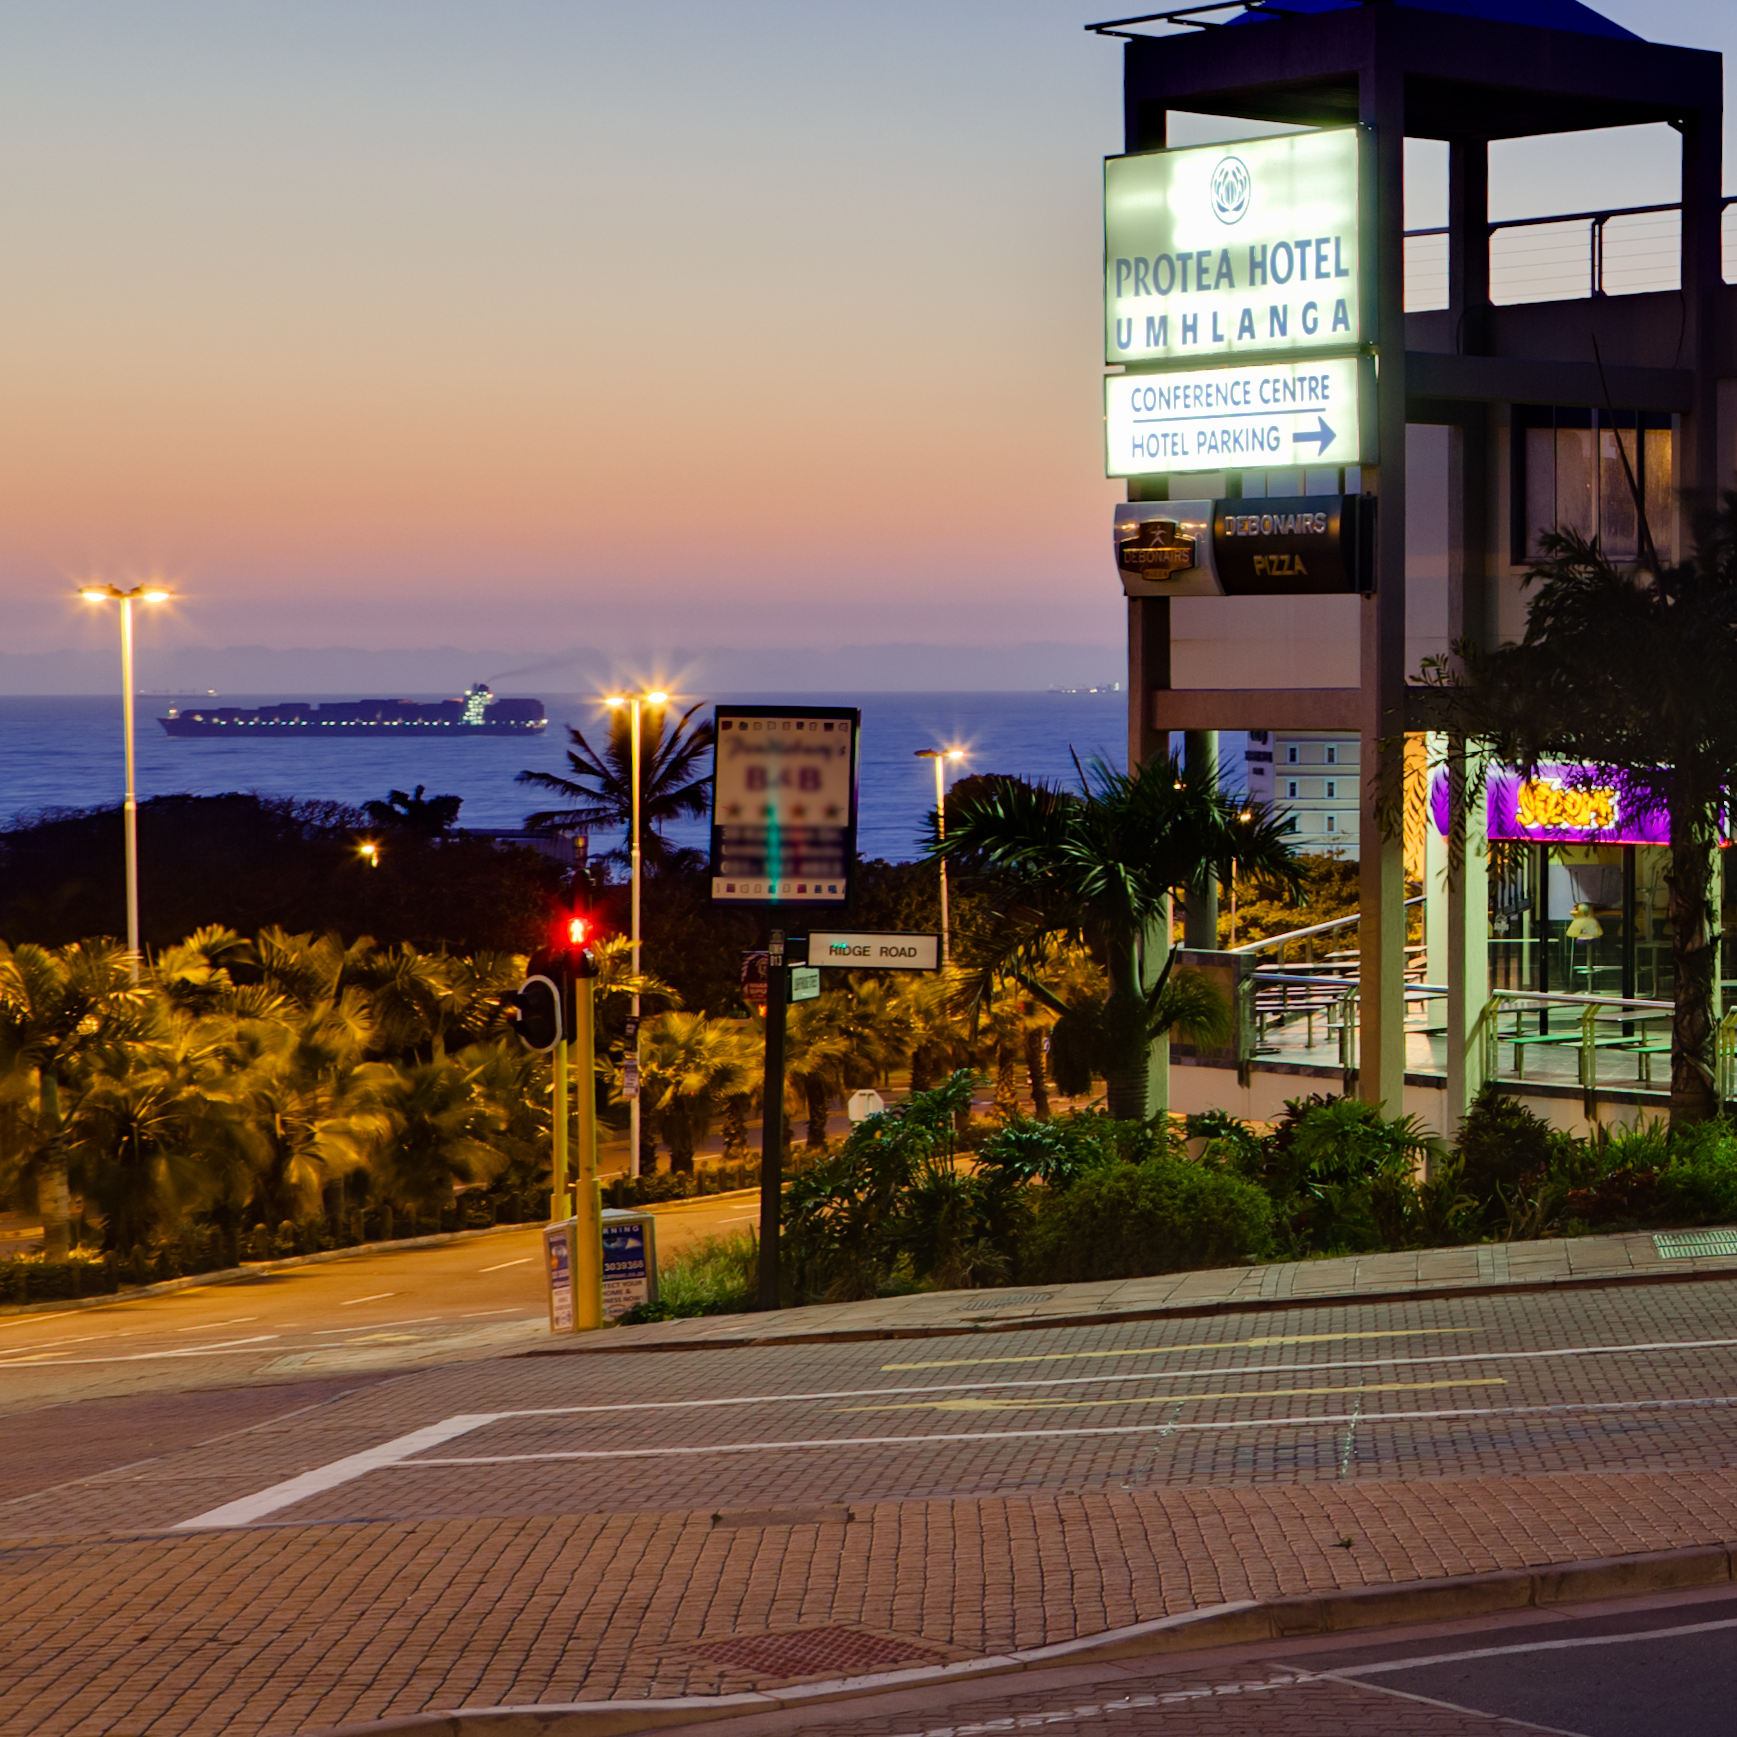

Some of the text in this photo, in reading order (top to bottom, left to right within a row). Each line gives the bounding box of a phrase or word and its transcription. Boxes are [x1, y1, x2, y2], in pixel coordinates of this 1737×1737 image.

[1115, 236, 1350, 298] PROTEA HOTEL
[1116, 298, 1350, 350] UMHLANGA
[1131, 375, 1330, 412] CONFERENCE CENTRE
[1132, 426, 1280, 458] HOTEL PARKING
[1224, 512, 1327, 537] DEBONAIRS
[1124, 550, 1190, 563] DEBONAIRS
[1253, 554, 1308, 576] PIZZA
[829, 945, 917, 958] RIDGE ROAD
[603, 1225, 639, 1235] RNING
